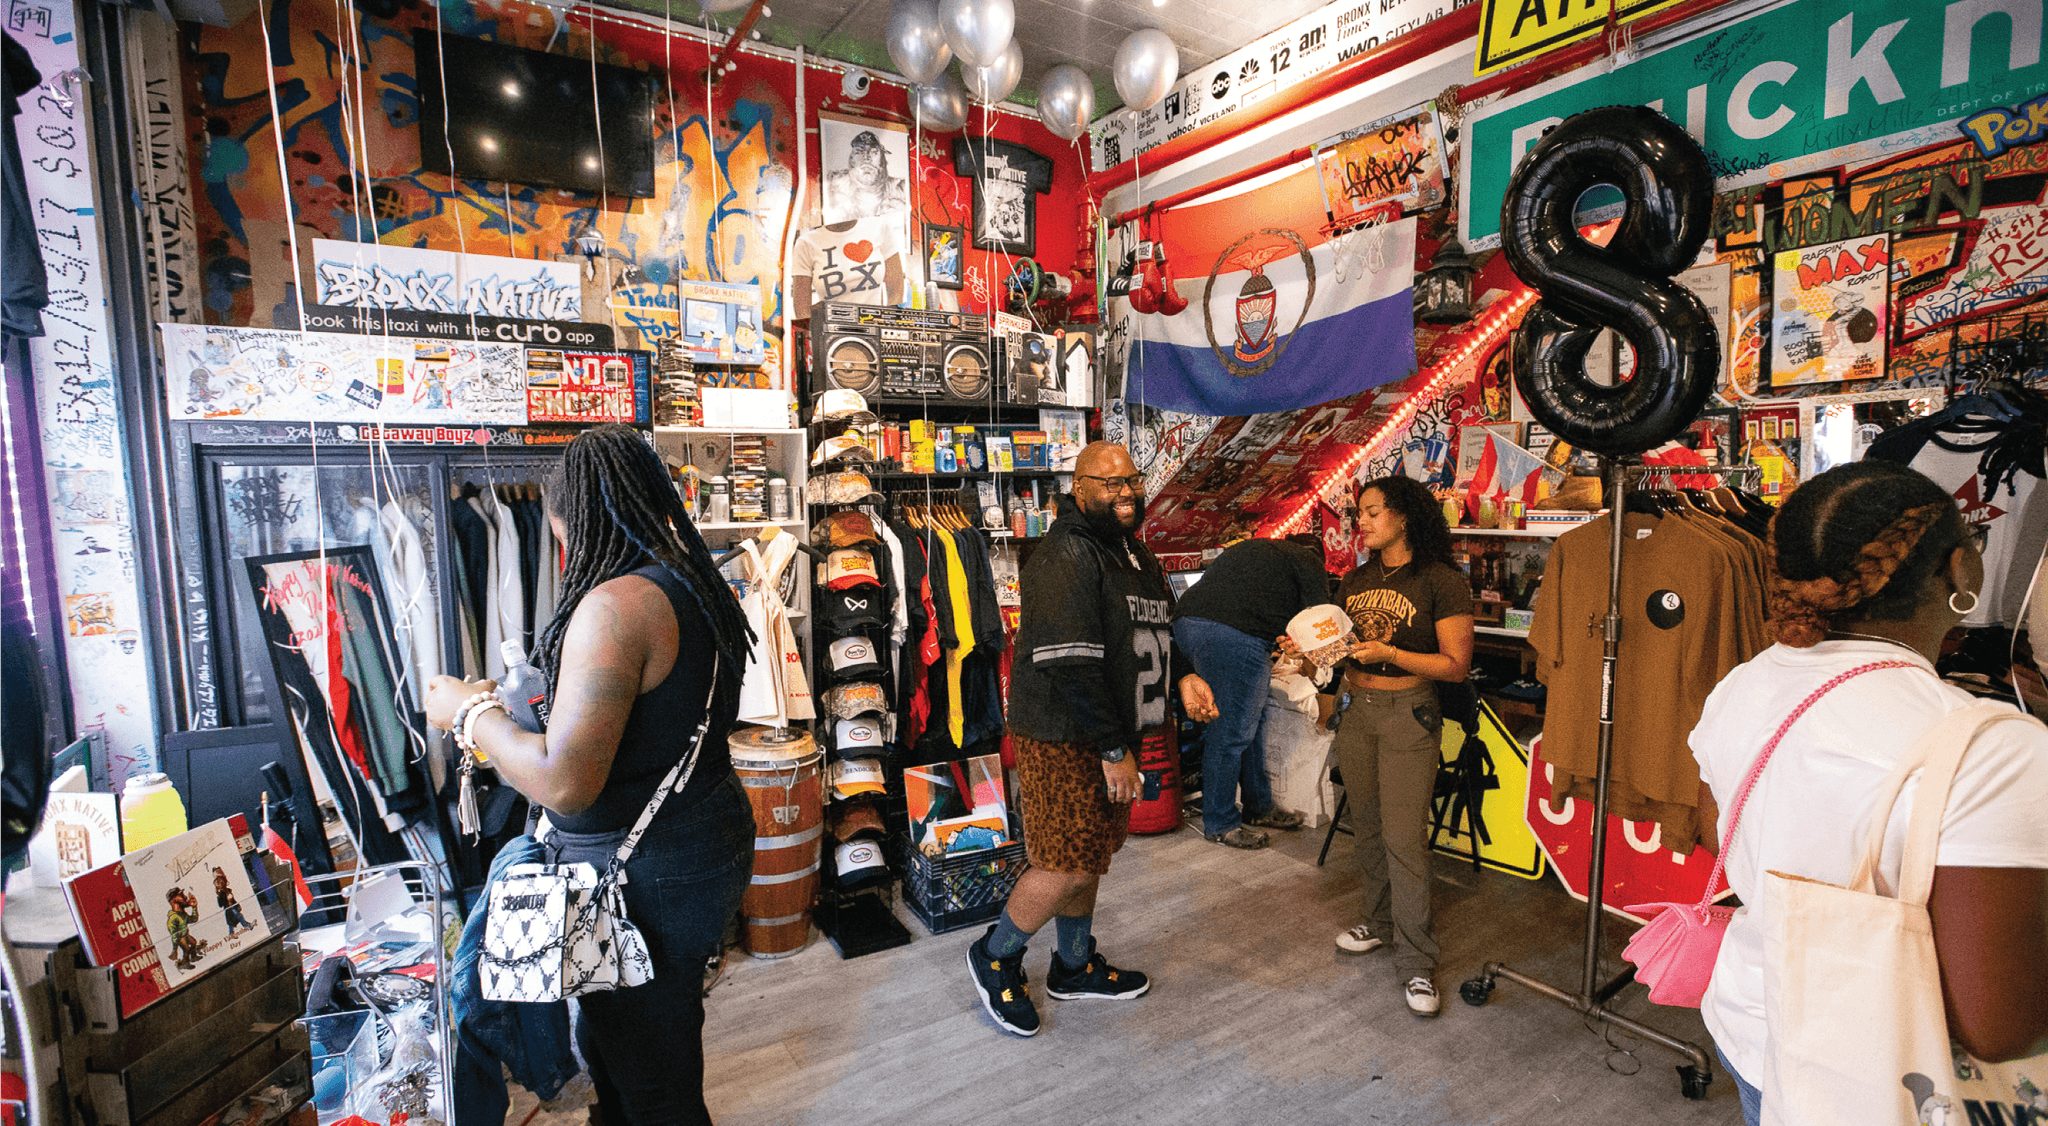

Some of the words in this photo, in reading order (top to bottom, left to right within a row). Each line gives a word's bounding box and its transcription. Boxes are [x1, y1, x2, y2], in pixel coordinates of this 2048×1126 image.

[1337, 1, 1371, 29] BRONX
[1270, 47, 1291, 75] 12
[1212, 79, 1231, 93] abc
[1199, 104, 1237, 126] VICELAND
[821, 246, 838, 272] I
[1797, 238, 1888, 290] MAX
[320, 260, 454, 312] BRONX
[467, 274, 582, 322] NATIVE
[819, 260, 882, 301] BX
[303, 313, 344, 329] Book
[352, 316, 381, 331] this
[388, 318, 419, 332] taxi
[426, 320, 458, 335] with
[466, 323, 490, 337] the
[496, 322, 562, 343] curb
[566, 331, 595, 345] app
[561, 357, 601, 385] NO
[530, 389, 633, 417] SMOKING
[360, 427, 435, 446] Getaway
[437, 428, 473, 446] Boyz
[74, 799, 116, 838] NATIVE
